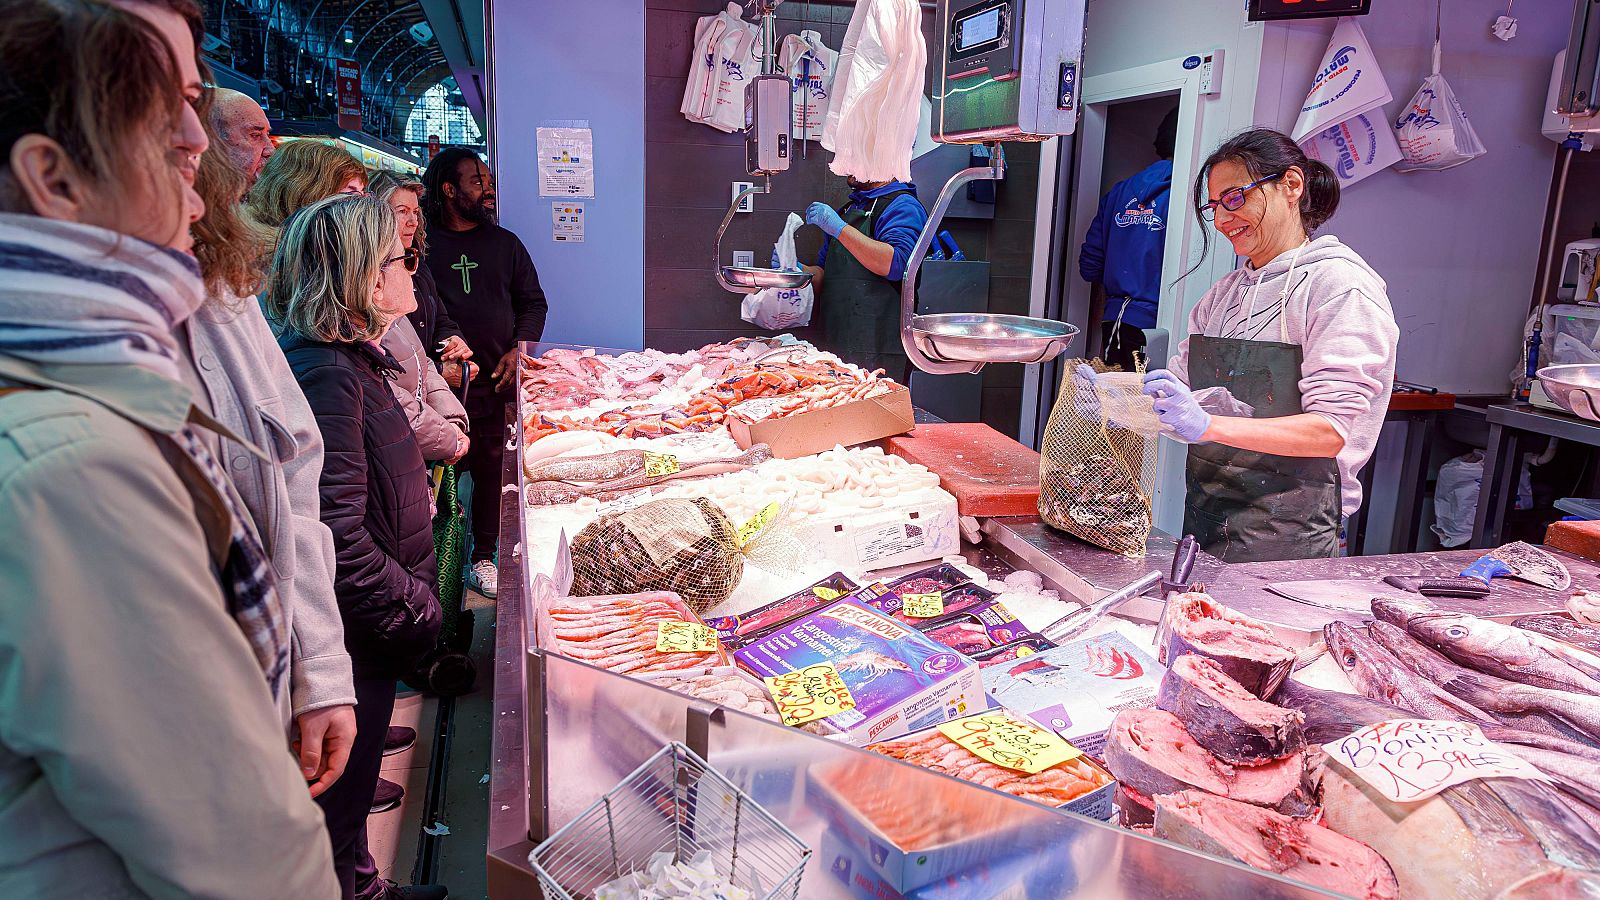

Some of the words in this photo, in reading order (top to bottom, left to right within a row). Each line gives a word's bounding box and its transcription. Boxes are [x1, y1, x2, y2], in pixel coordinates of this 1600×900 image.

[1328, 65, 1349, 79] DAVID
[829, 606, 903, 639] PESCANOVA
[790, 625, 835, 658] Vannamei
[903, 695, 933, 714] Langostino
[868, 714, 900, 738] PESCANOVA
[1361, 721, 1473, 744] FRESCO
[1341, 732, 1485, 769] BONITO
